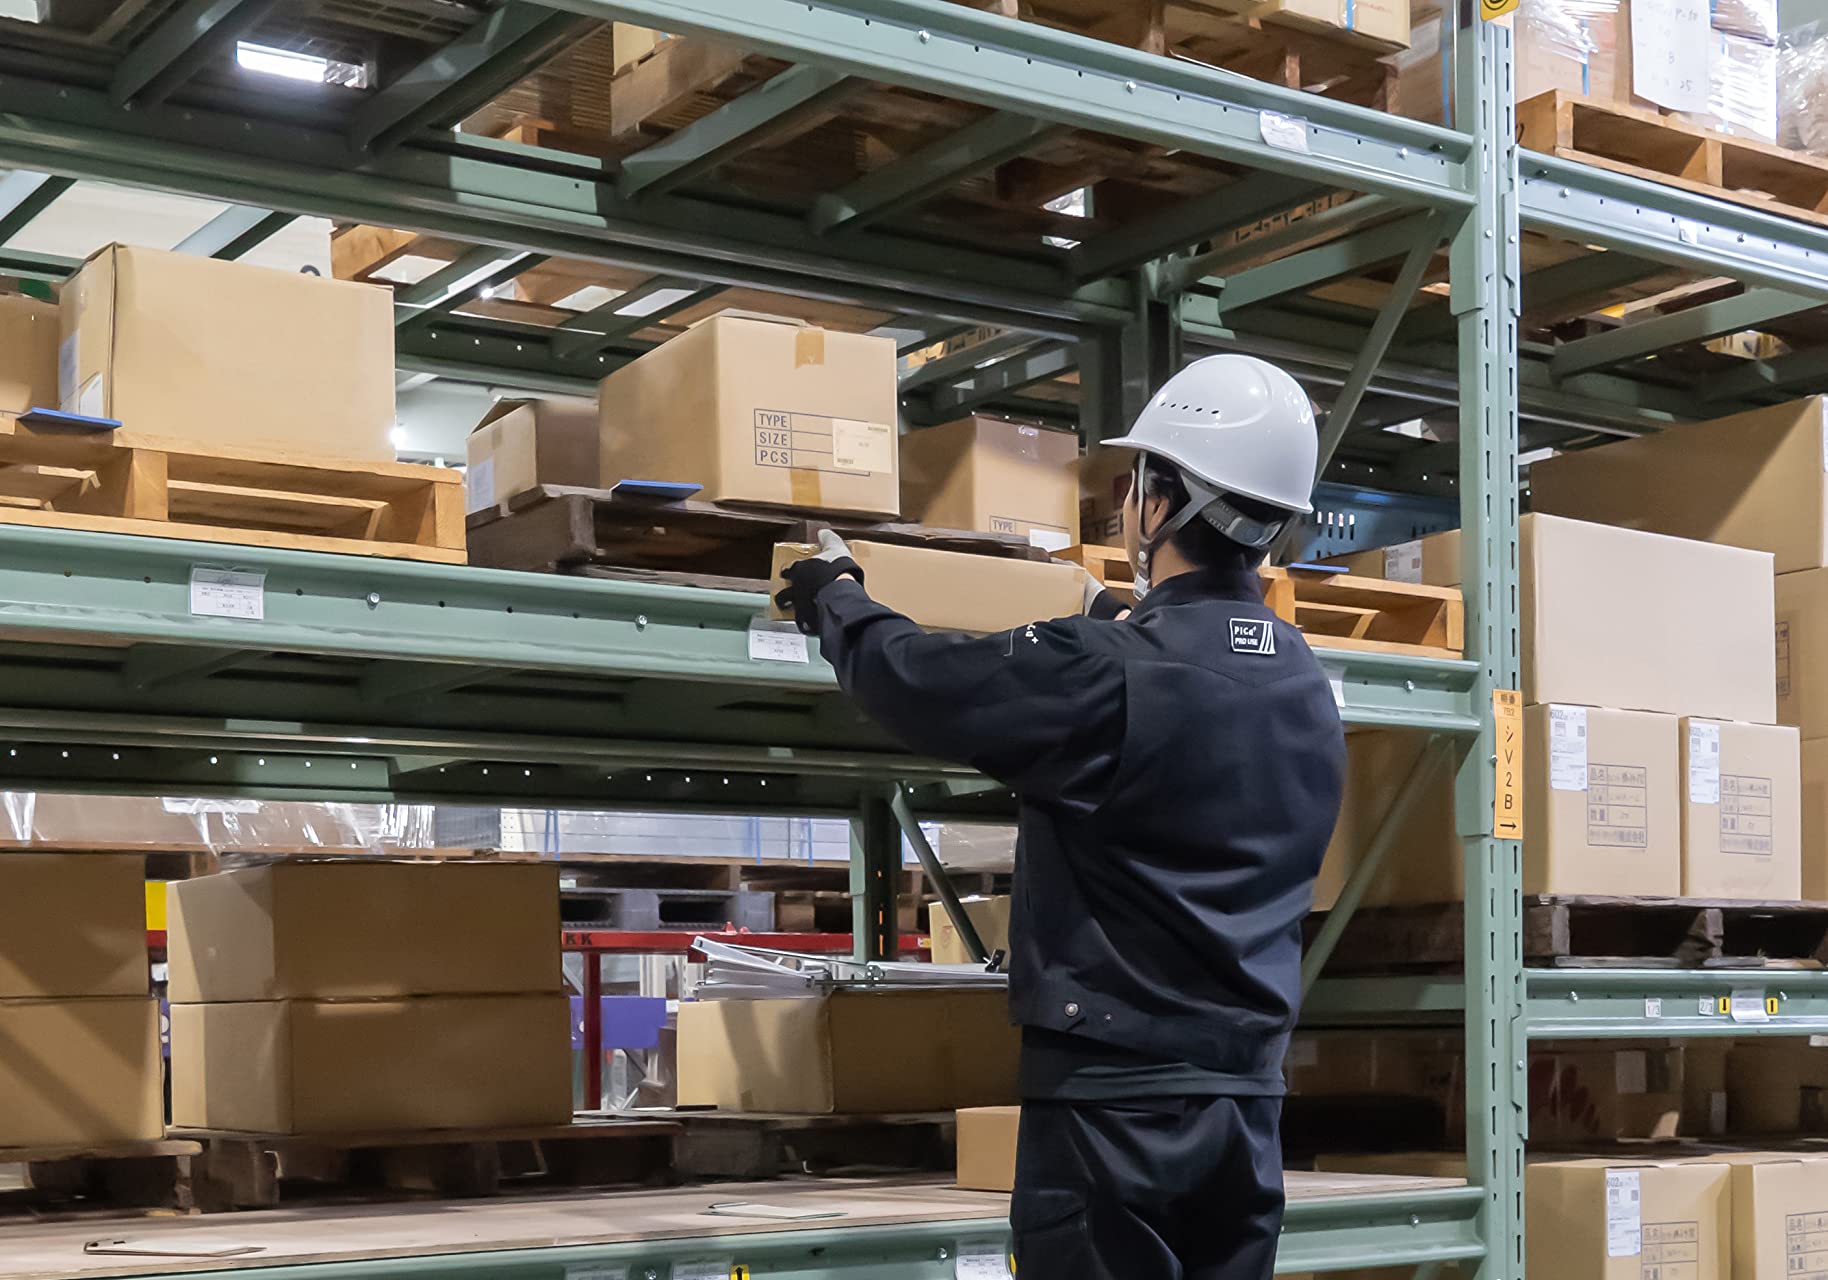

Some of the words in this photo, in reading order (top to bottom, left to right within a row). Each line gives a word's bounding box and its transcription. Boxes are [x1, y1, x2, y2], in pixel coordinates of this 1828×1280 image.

[759, 413, 788, 428] TYPE
[759, 431, 788, 446] SIZE
[760, 450, 789, 464] PCS
[992, 519, 1013, 533] TYPE
[1234, 637, 1247, 645] PRO
